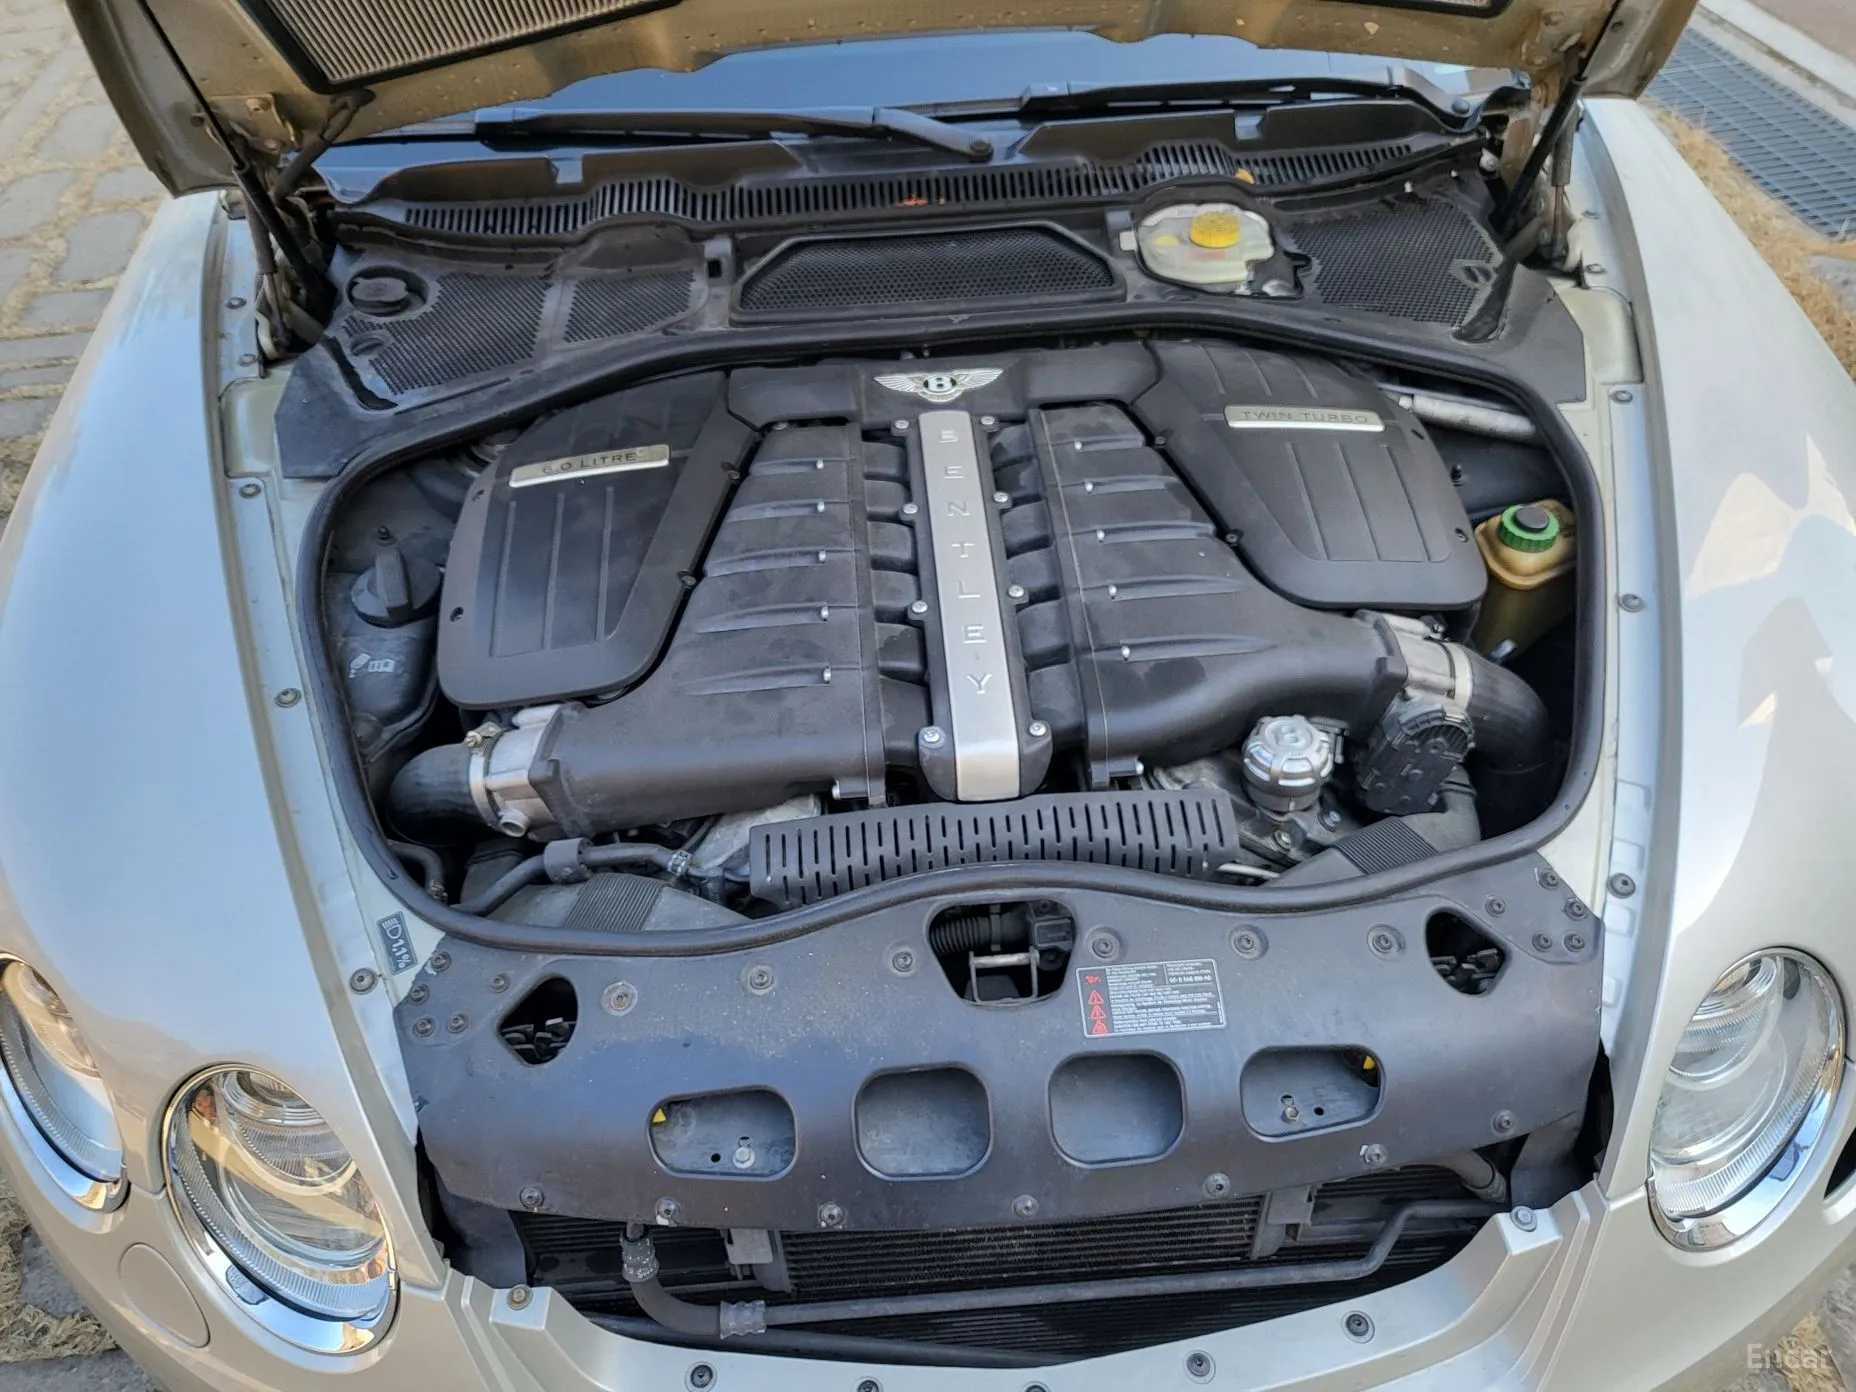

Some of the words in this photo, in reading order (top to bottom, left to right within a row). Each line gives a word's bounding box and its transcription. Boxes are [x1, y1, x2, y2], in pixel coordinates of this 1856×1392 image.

[927, 375, 954, 393] B
[1241, 411, 1292, 421] TWIN
[1301, 412, 1368, 424] TURBO
[580, 453, 637, 468] LITRE
[939, 429, 992, 694] BENTLEY
